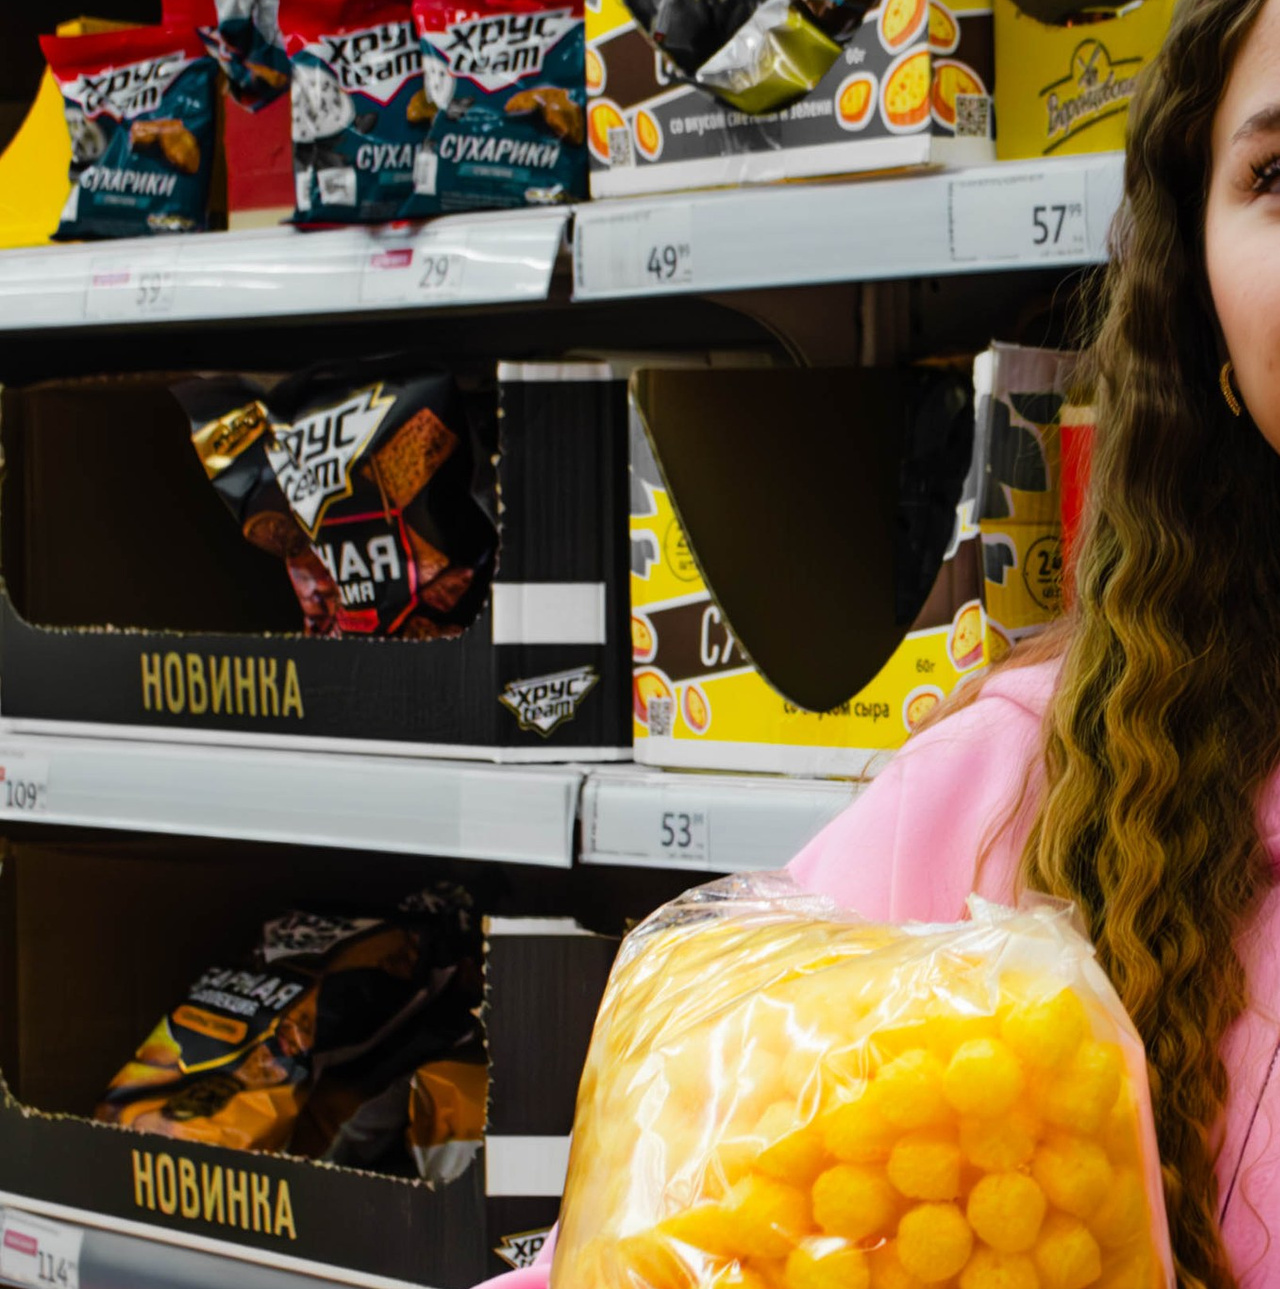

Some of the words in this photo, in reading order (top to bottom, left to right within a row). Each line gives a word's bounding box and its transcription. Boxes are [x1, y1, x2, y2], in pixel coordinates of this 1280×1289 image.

[445, 11, 564, 51] хрус
[440, 133, 560, 169] СУХАРИКИ
[80, 165, 178, 198] СУХАРИКИ
[1032, 205, 1066, 245] 57
[419, 256, 449, 289] 29
[646, 244, 677, 280] 49
[141, 651, 304, 718] НОВИНКА
[517, 677, 581, 707] хрус
[854, 701, 891, 723] сыра
[6, 779, 37, 809] 109
[660, 812, 692, 848] 53
[131, 1150, 298, 1241] НОВИНКА
[38, 1250, 68, 1288] 114
